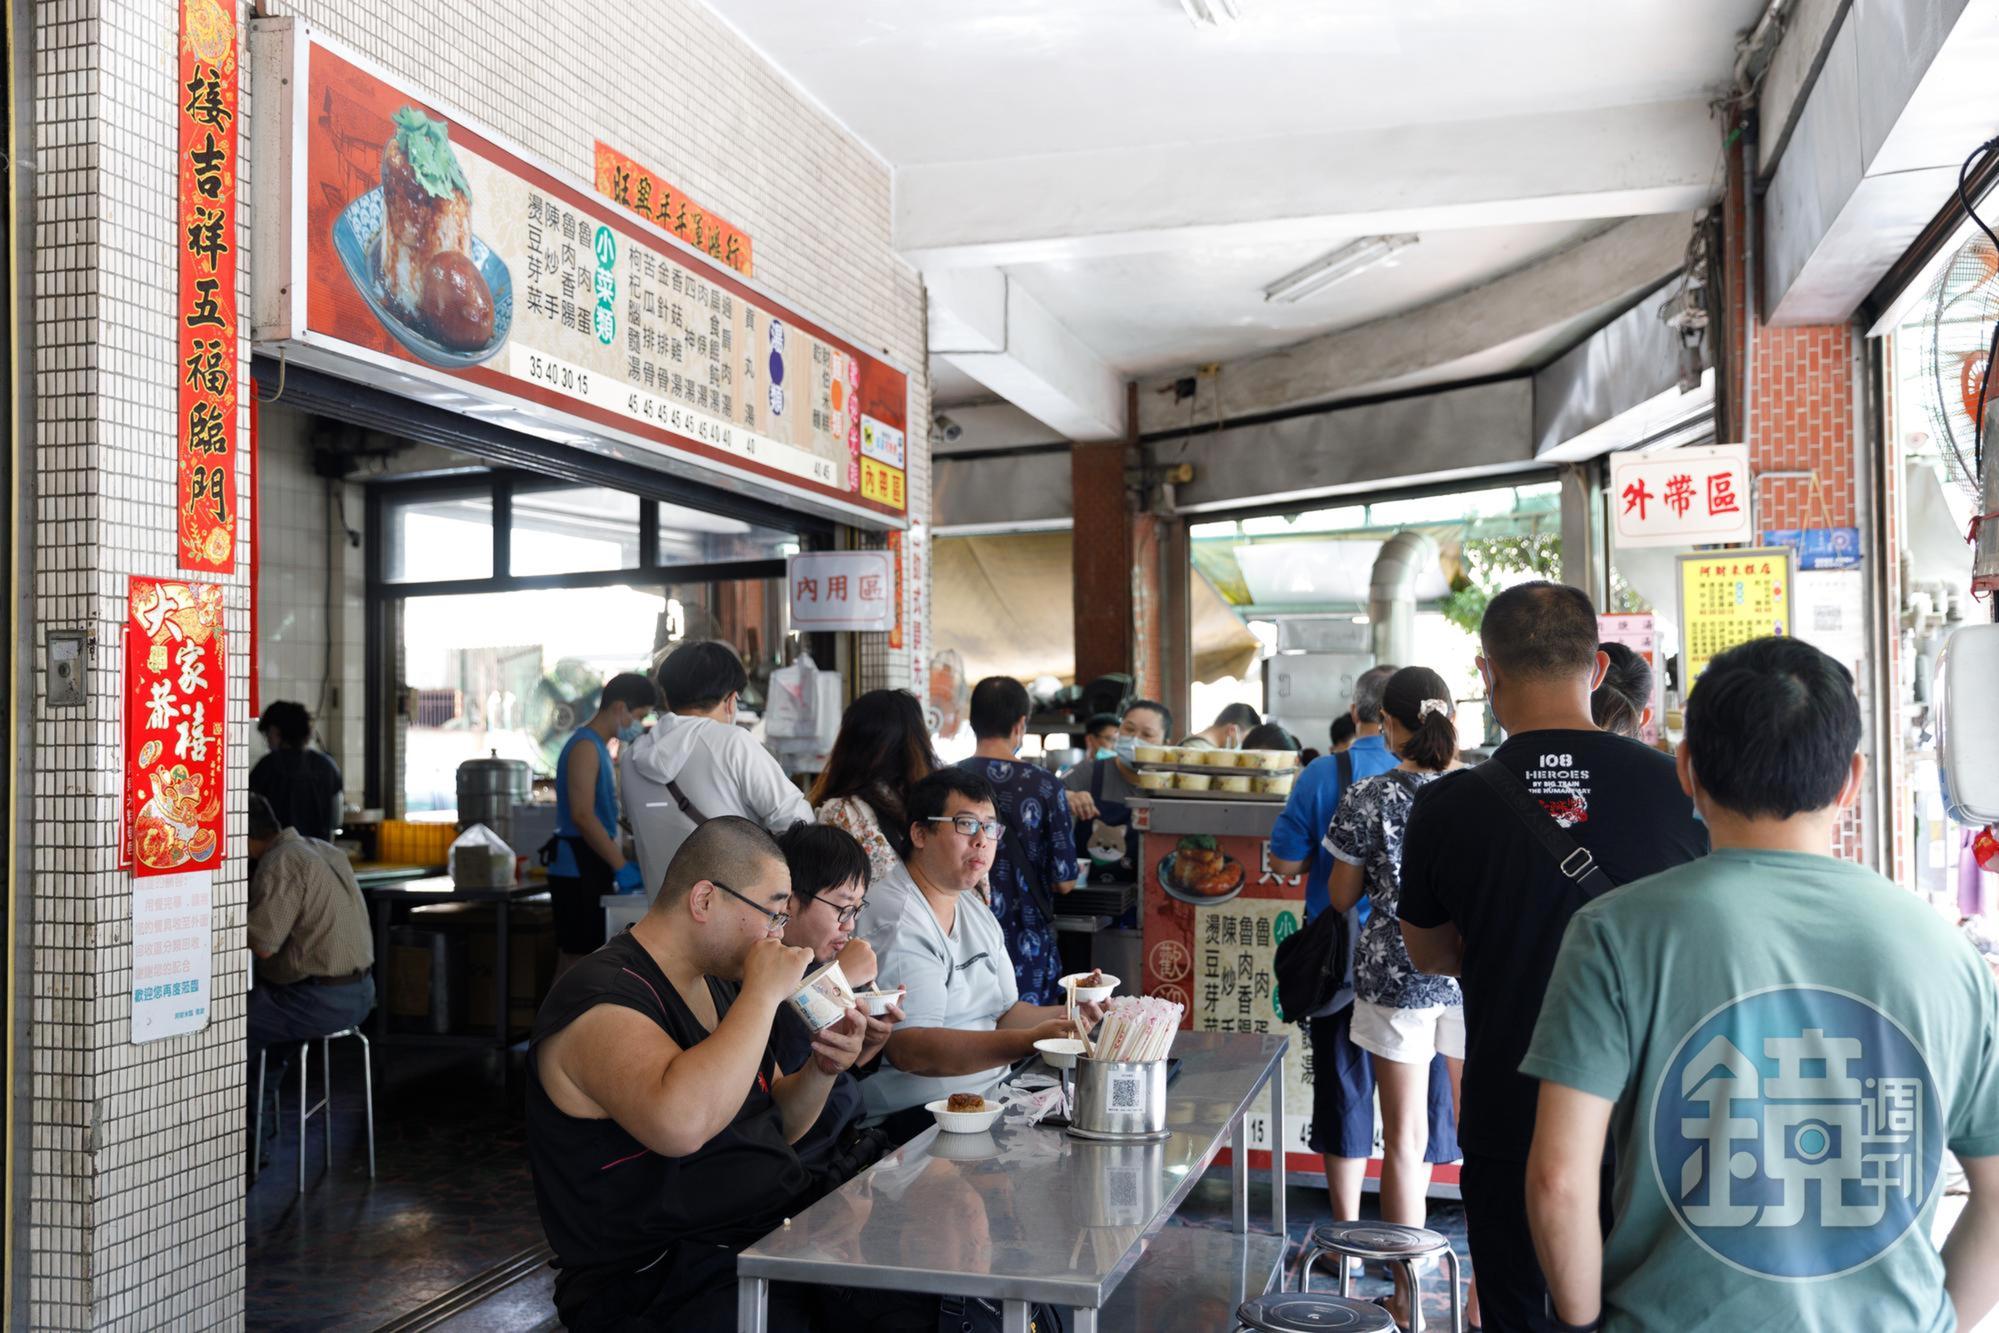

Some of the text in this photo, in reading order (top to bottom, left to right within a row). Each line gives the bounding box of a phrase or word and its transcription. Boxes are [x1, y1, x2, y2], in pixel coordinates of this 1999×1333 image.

[527, 192, 543, 315] 燙豆芽菜
[561, 210, 577, 329] 魯肉香腸
[577, 220, 592, 337] 魯肉蛋
[185, 64, 232, 522] 接吉祥五福臨門
[596, 228, 615, 341] 小菜類
[643, 253, 656, 388] 苦瓜排骨
[657, 261, 670, 392] 金針排骨
[530, 356, 543, 380] 35
[545, 361, 558, 386] 40
[561, 365, 574, 390] 30
[578, 370, 589, 395] 15
[628, 393, 639, 415] 45
[643, 399, 654, 420] 45
[657, 403, 669, 424] 45
[671, 409, 682, 429] 45
[684, 414, 695, 434] 45
[1621, 470, 1740, 522] 外帶區
[796, 574, 884, 603] 內用區
[1539, 753, 1573, 768] 108
[1525, 770, 1590, 780] HEROES
[1251, 1118, 1264, 1143] 15
